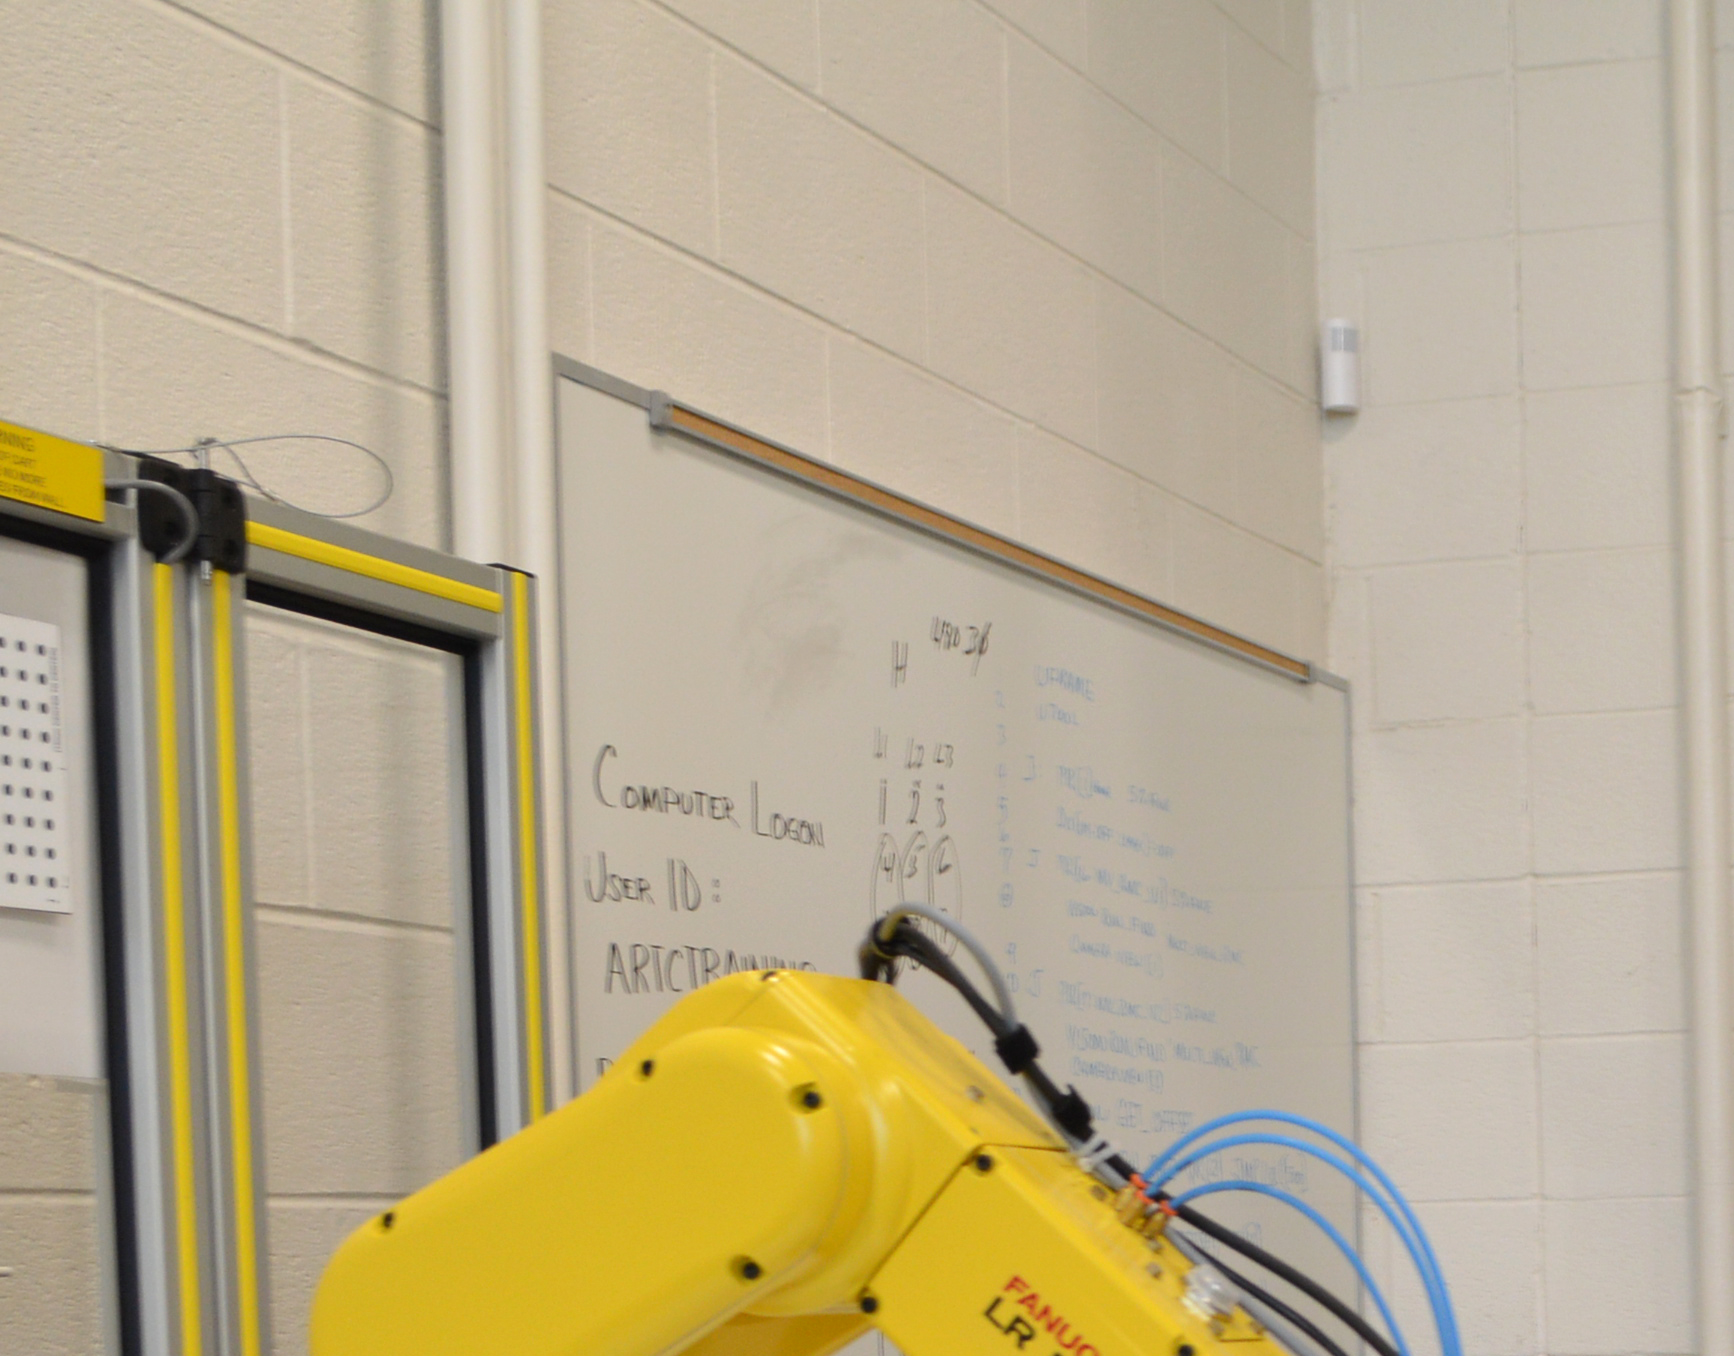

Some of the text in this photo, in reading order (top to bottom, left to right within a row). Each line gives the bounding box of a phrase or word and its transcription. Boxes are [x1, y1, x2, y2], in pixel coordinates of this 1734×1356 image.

[593, 744, 826, 849] COMPUTER LOGON
[584, 852, 655, 906] USER
[983, 1296, 1036, 1350] LR
